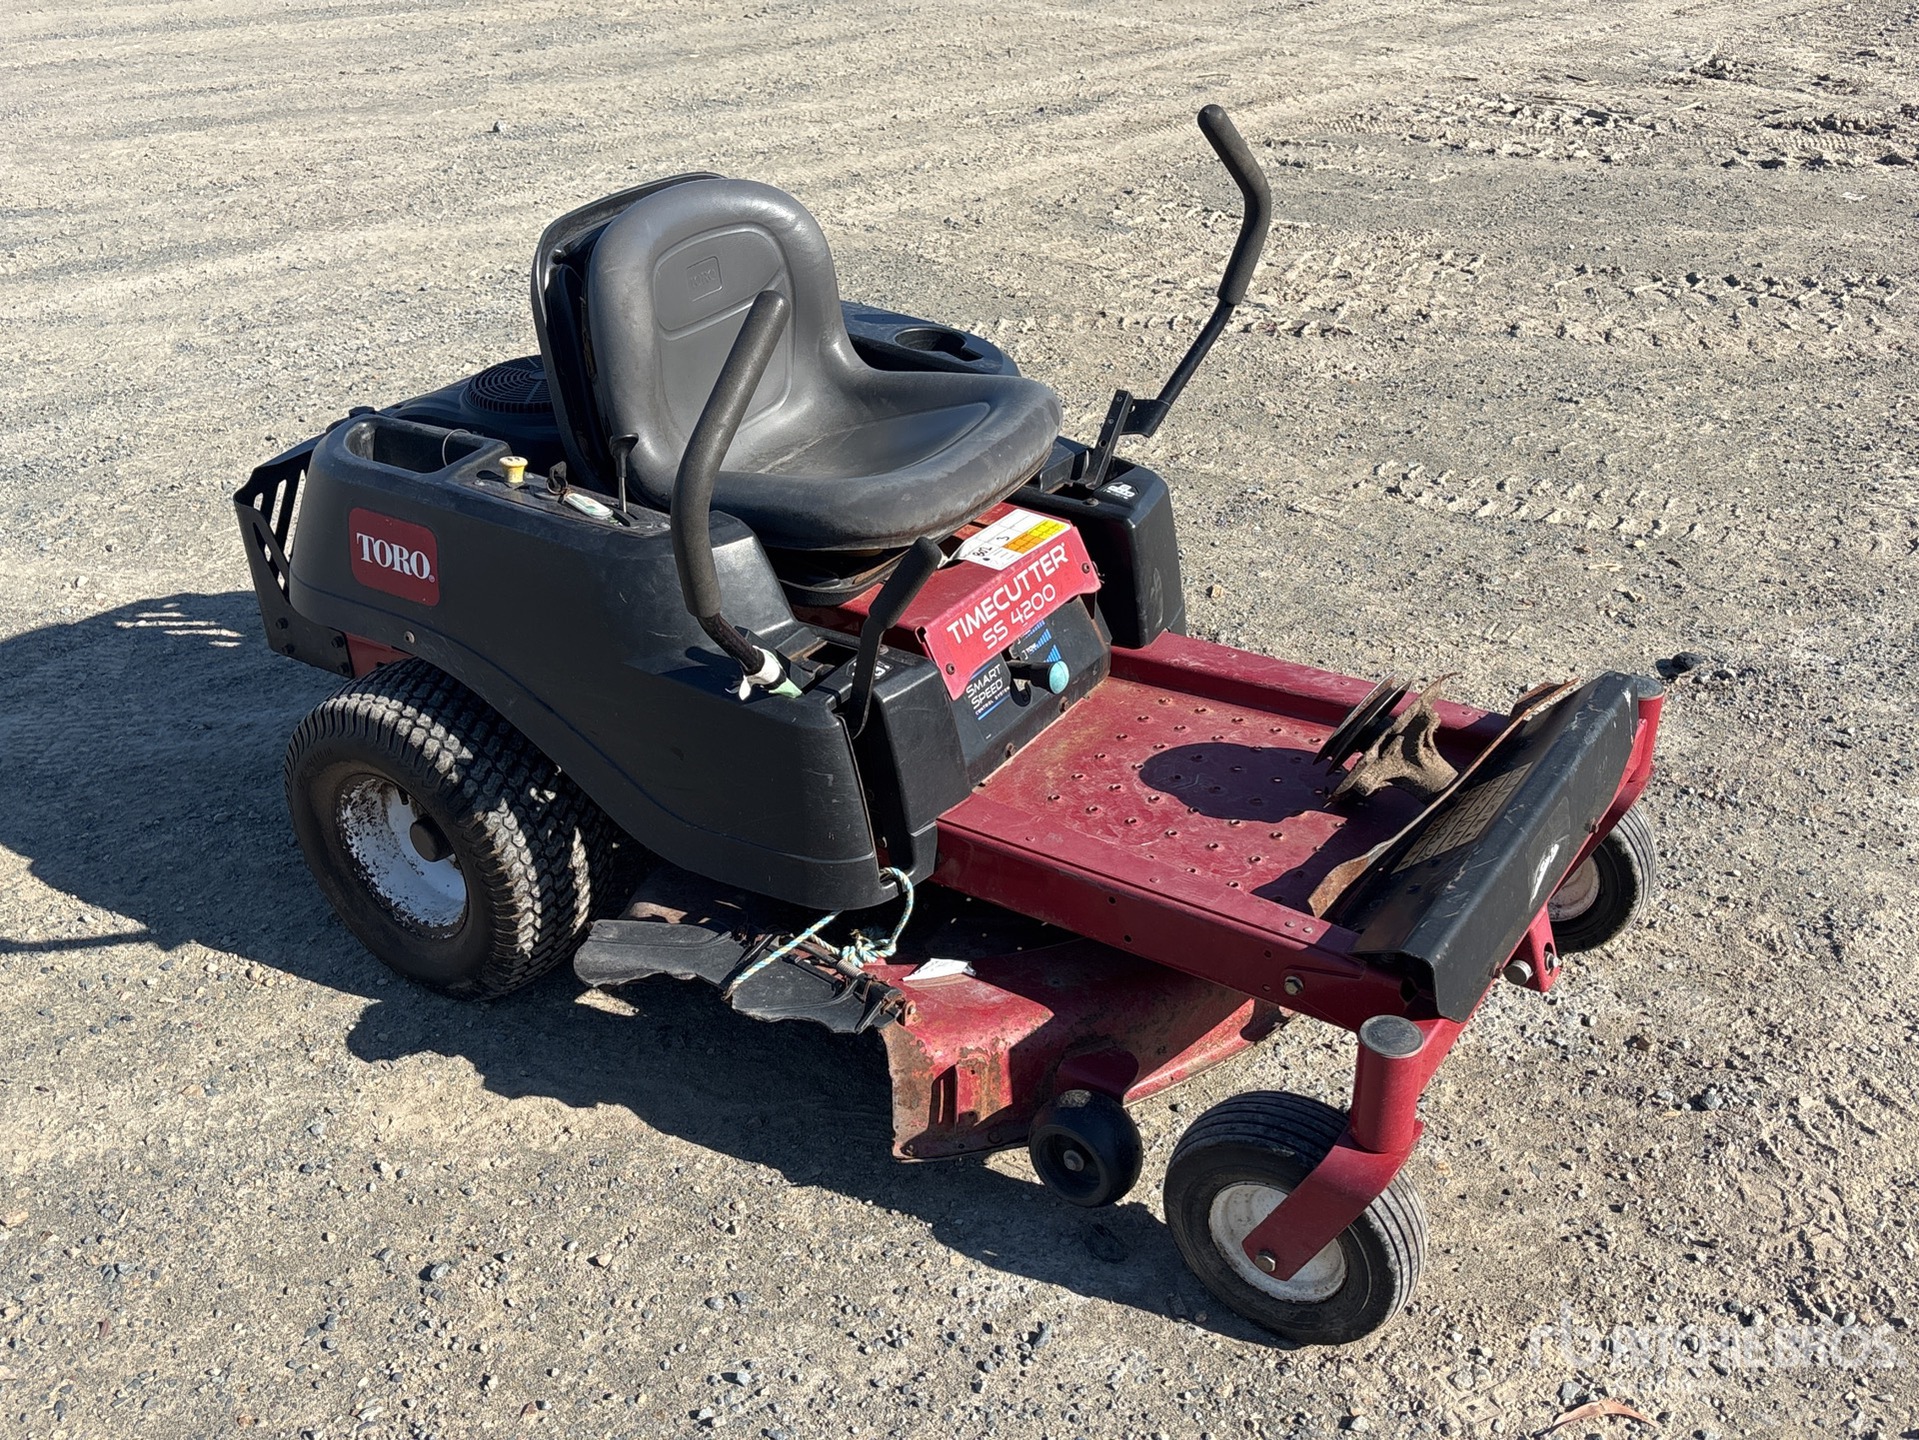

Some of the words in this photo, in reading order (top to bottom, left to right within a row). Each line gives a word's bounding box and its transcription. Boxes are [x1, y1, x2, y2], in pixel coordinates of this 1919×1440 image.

[356, 532, 431, 580] TORO
[946, 543, 1069, 645] TIMECUTTER
[982, 619, 1008, 650] SS
[1010, 583, 1056, 624] 4200
[965, 663, 1001, 699] SMART
[971, 677, 1003, 710] SPEED
